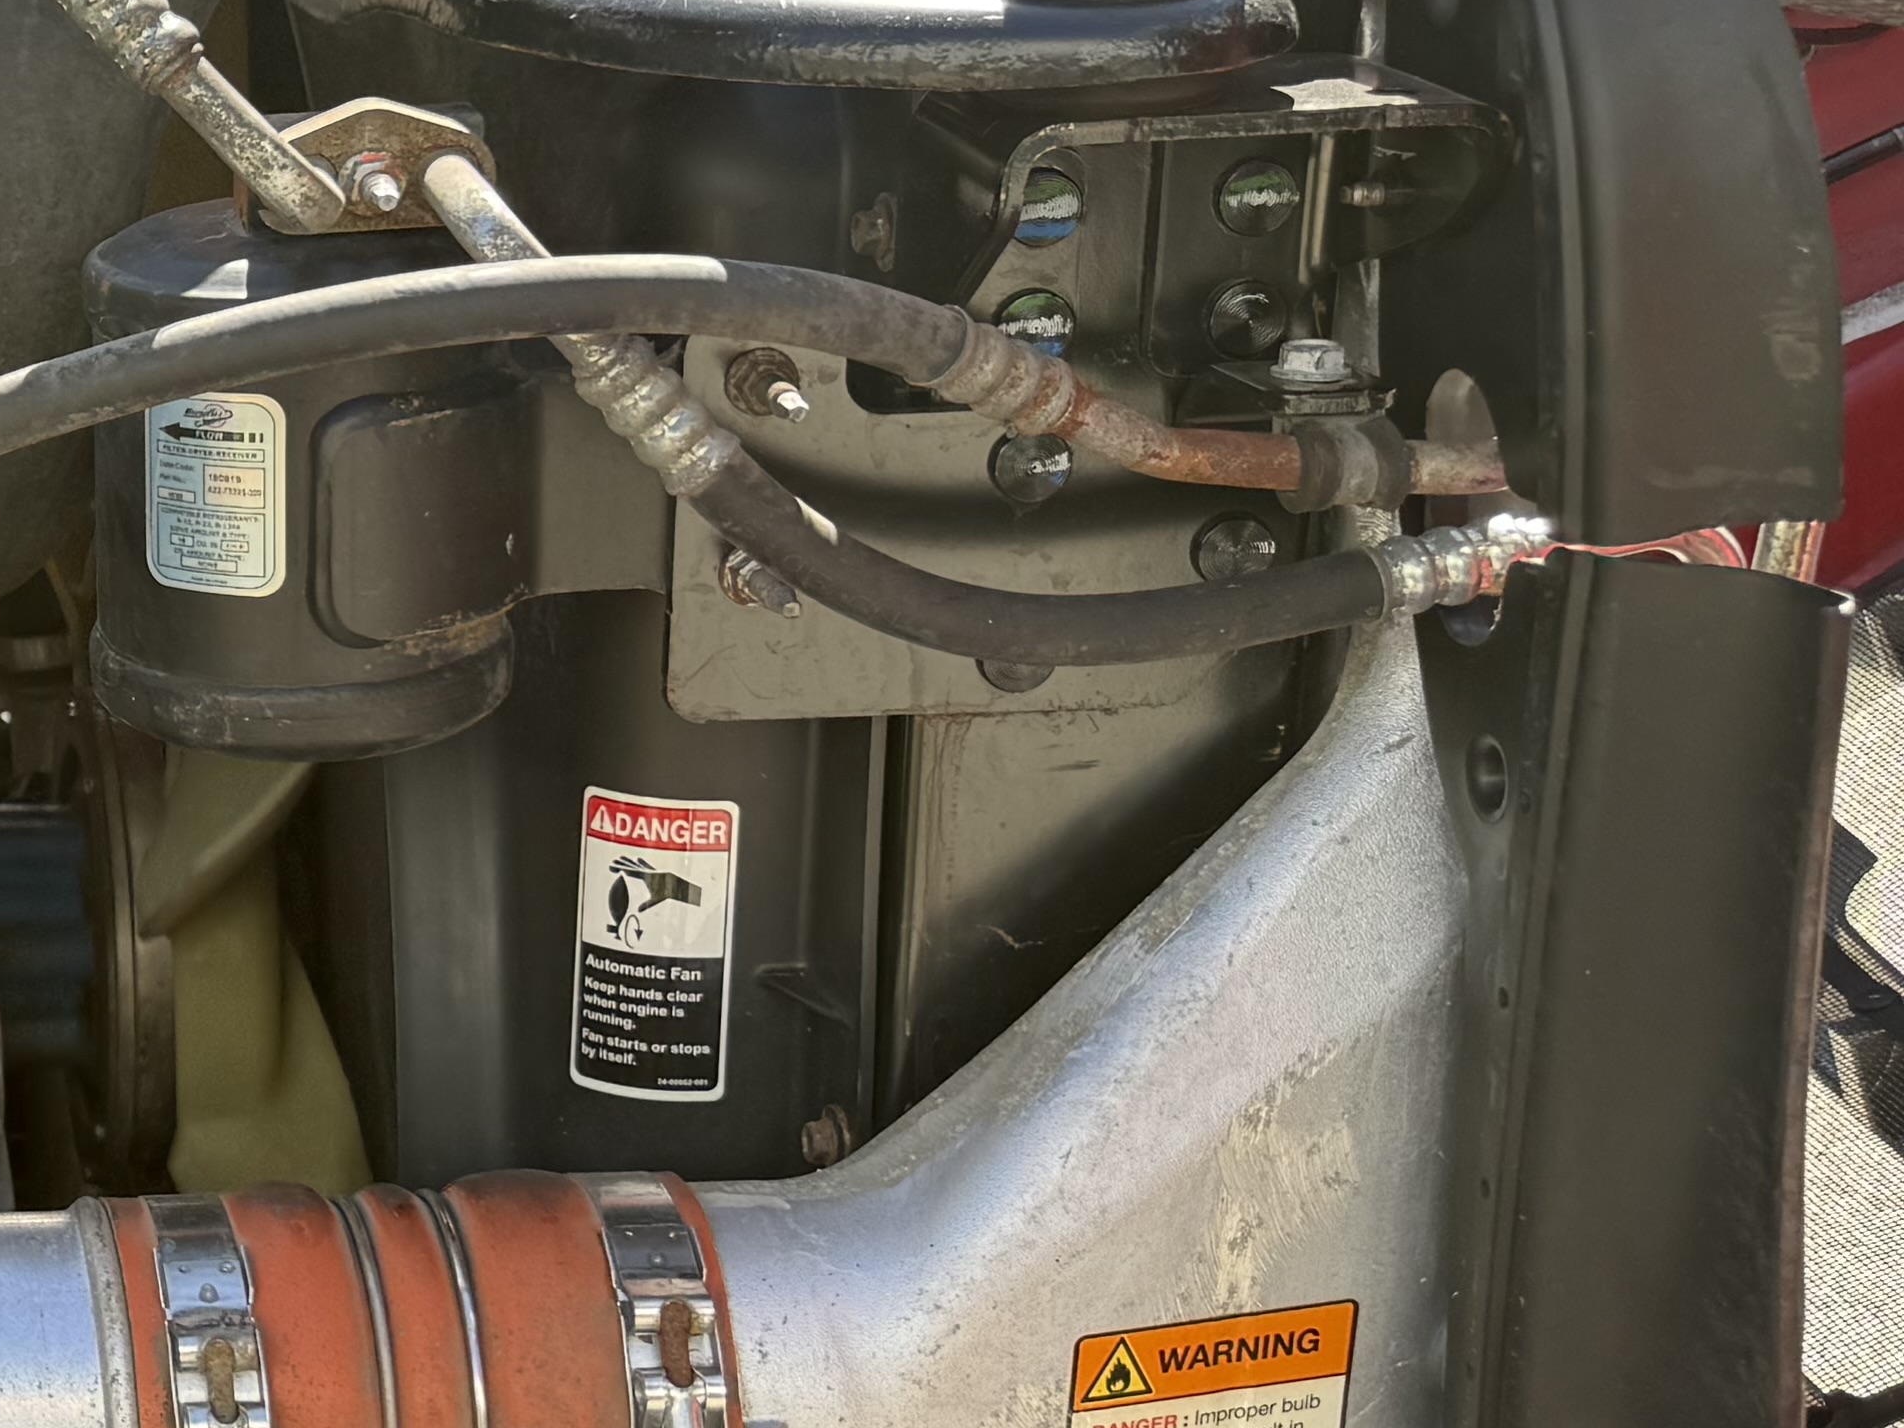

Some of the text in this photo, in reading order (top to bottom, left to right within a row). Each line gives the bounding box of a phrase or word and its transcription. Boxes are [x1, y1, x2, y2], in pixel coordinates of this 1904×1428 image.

[614, 811, 727, 845] DANGER
[585, 953, 702, 981] Automatic Fan
[584, 975, 703, 1003] Keep hands clear
[582, 1007, 637, 1030] running.
[583, 992, 685, 1018] when engine is
[581, 1042, 637, 1066] by itself.
[582, 1027, 711, 1056] Fan starts or stops
[1158, 1328, 1321, 1374] WARNING
[1194, 1402, 1277, 1428] Improper
[1281, 1393, 1321, 1412] bulb
